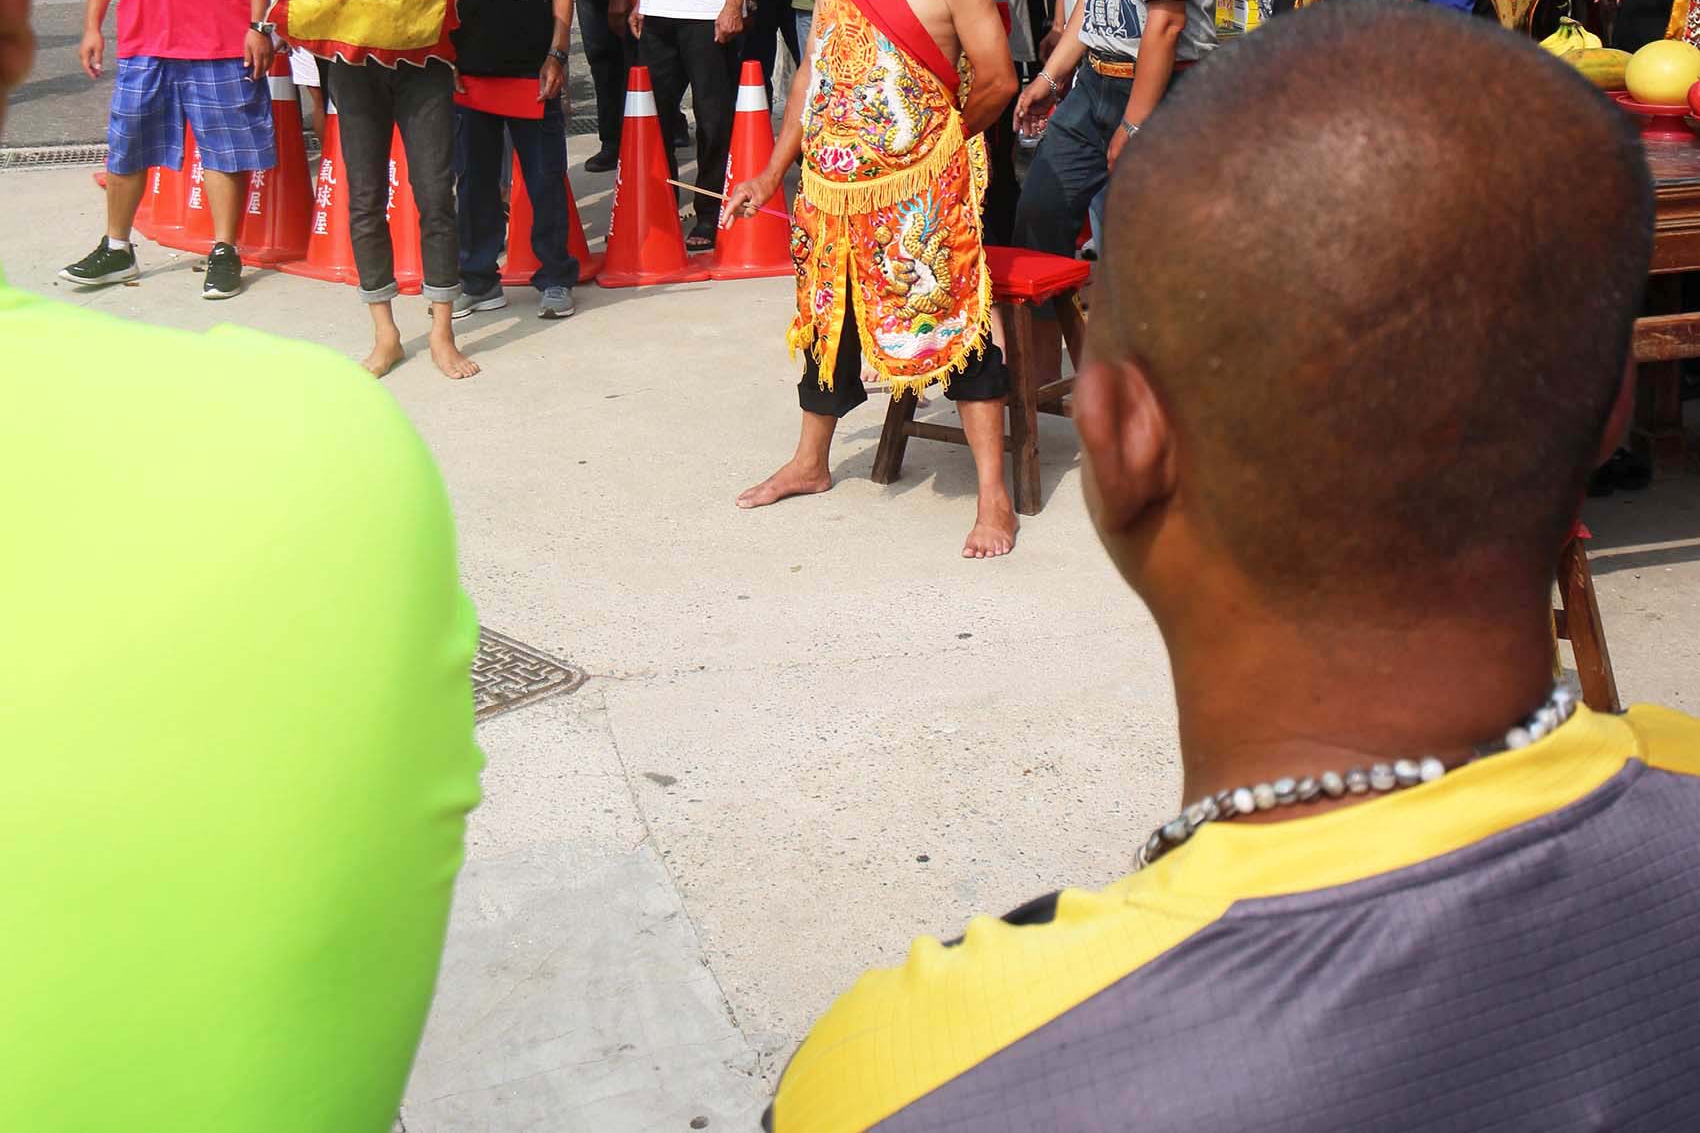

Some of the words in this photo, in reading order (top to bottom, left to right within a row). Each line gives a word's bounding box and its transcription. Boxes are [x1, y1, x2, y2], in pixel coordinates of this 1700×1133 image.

[189, 147, 205, 209] 球屋
[313, 158, 337, 235] 氣球屋
